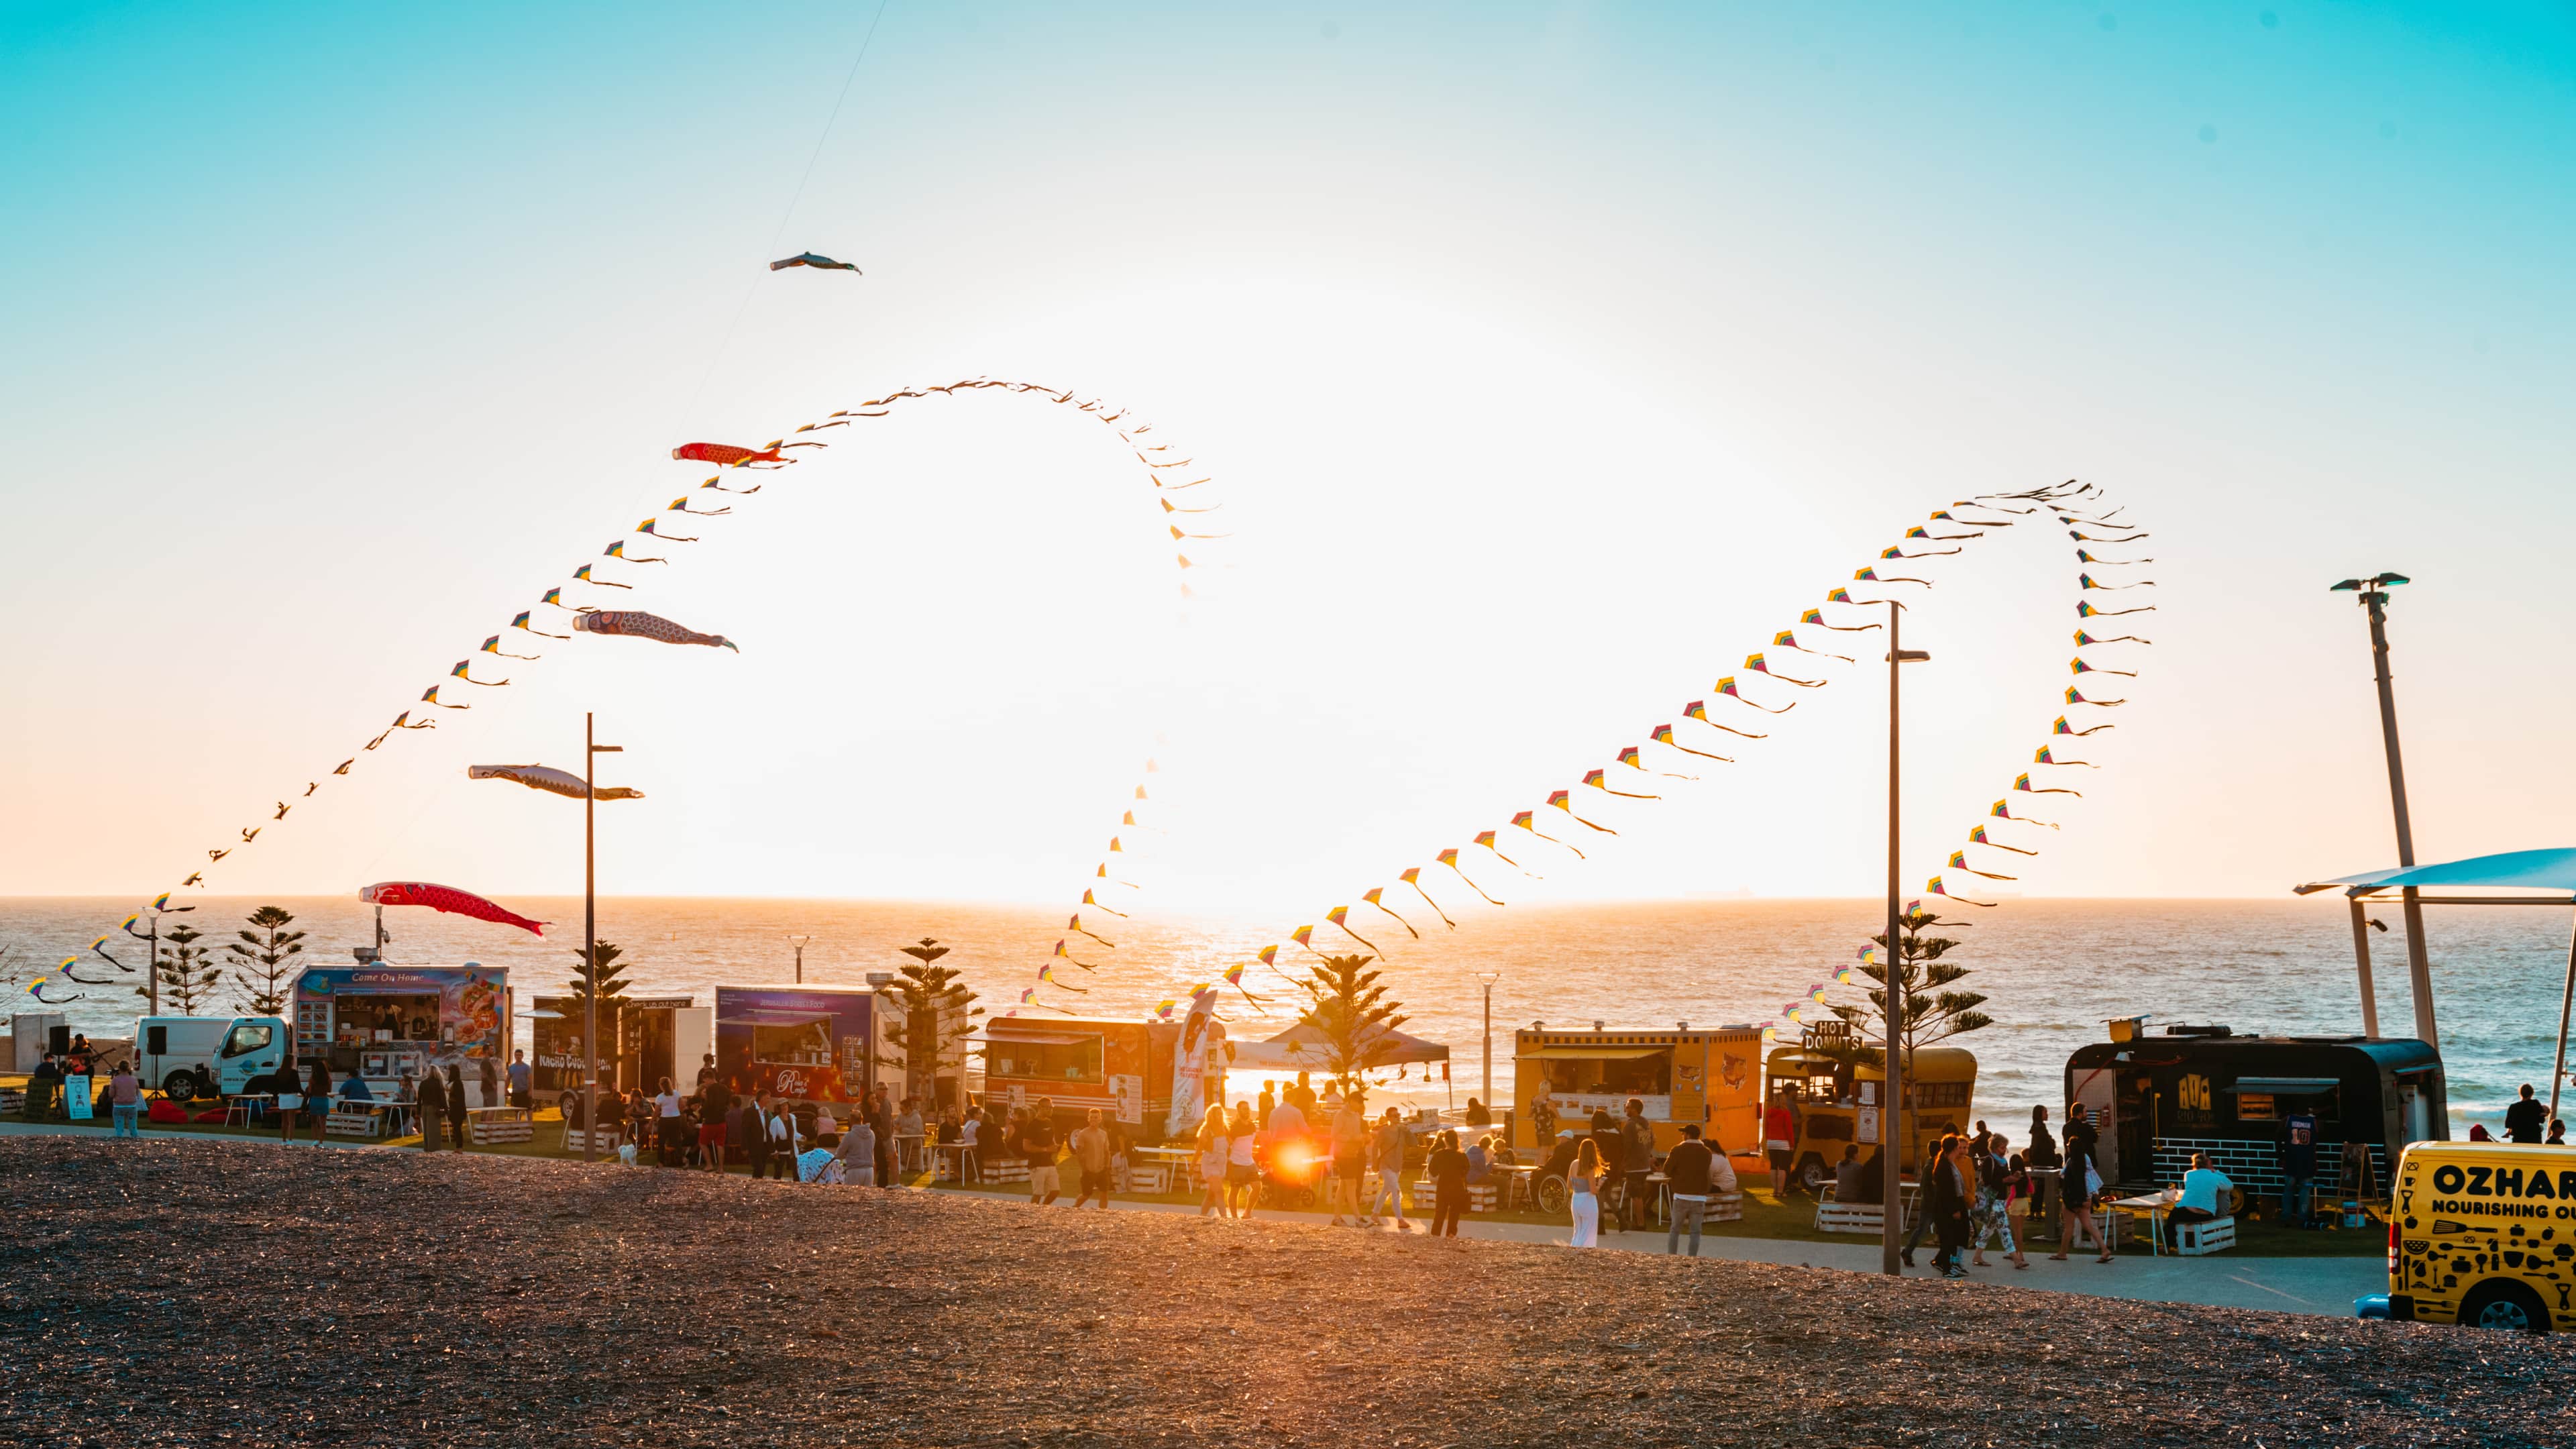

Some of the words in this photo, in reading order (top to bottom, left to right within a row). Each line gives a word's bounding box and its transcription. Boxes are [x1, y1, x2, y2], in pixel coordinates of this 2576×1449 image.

[352, 973, 378, 982] Come
[380, 974, 394, 982] On
[397, 973, 425, 982] Home
[790, 1000, 809, 1008] STREET
[810, 1000, 825, 1008] FOOD
[1819, 1022, 1845, 1034] HOT
[1805, 1035, 1860, 1051] DONUTS
[539, 1055, 565, 1068] NACHO
[2291, 1128, 2311, 1145] 10
[2432, 1199, 2548, 1218] NOURISHING
